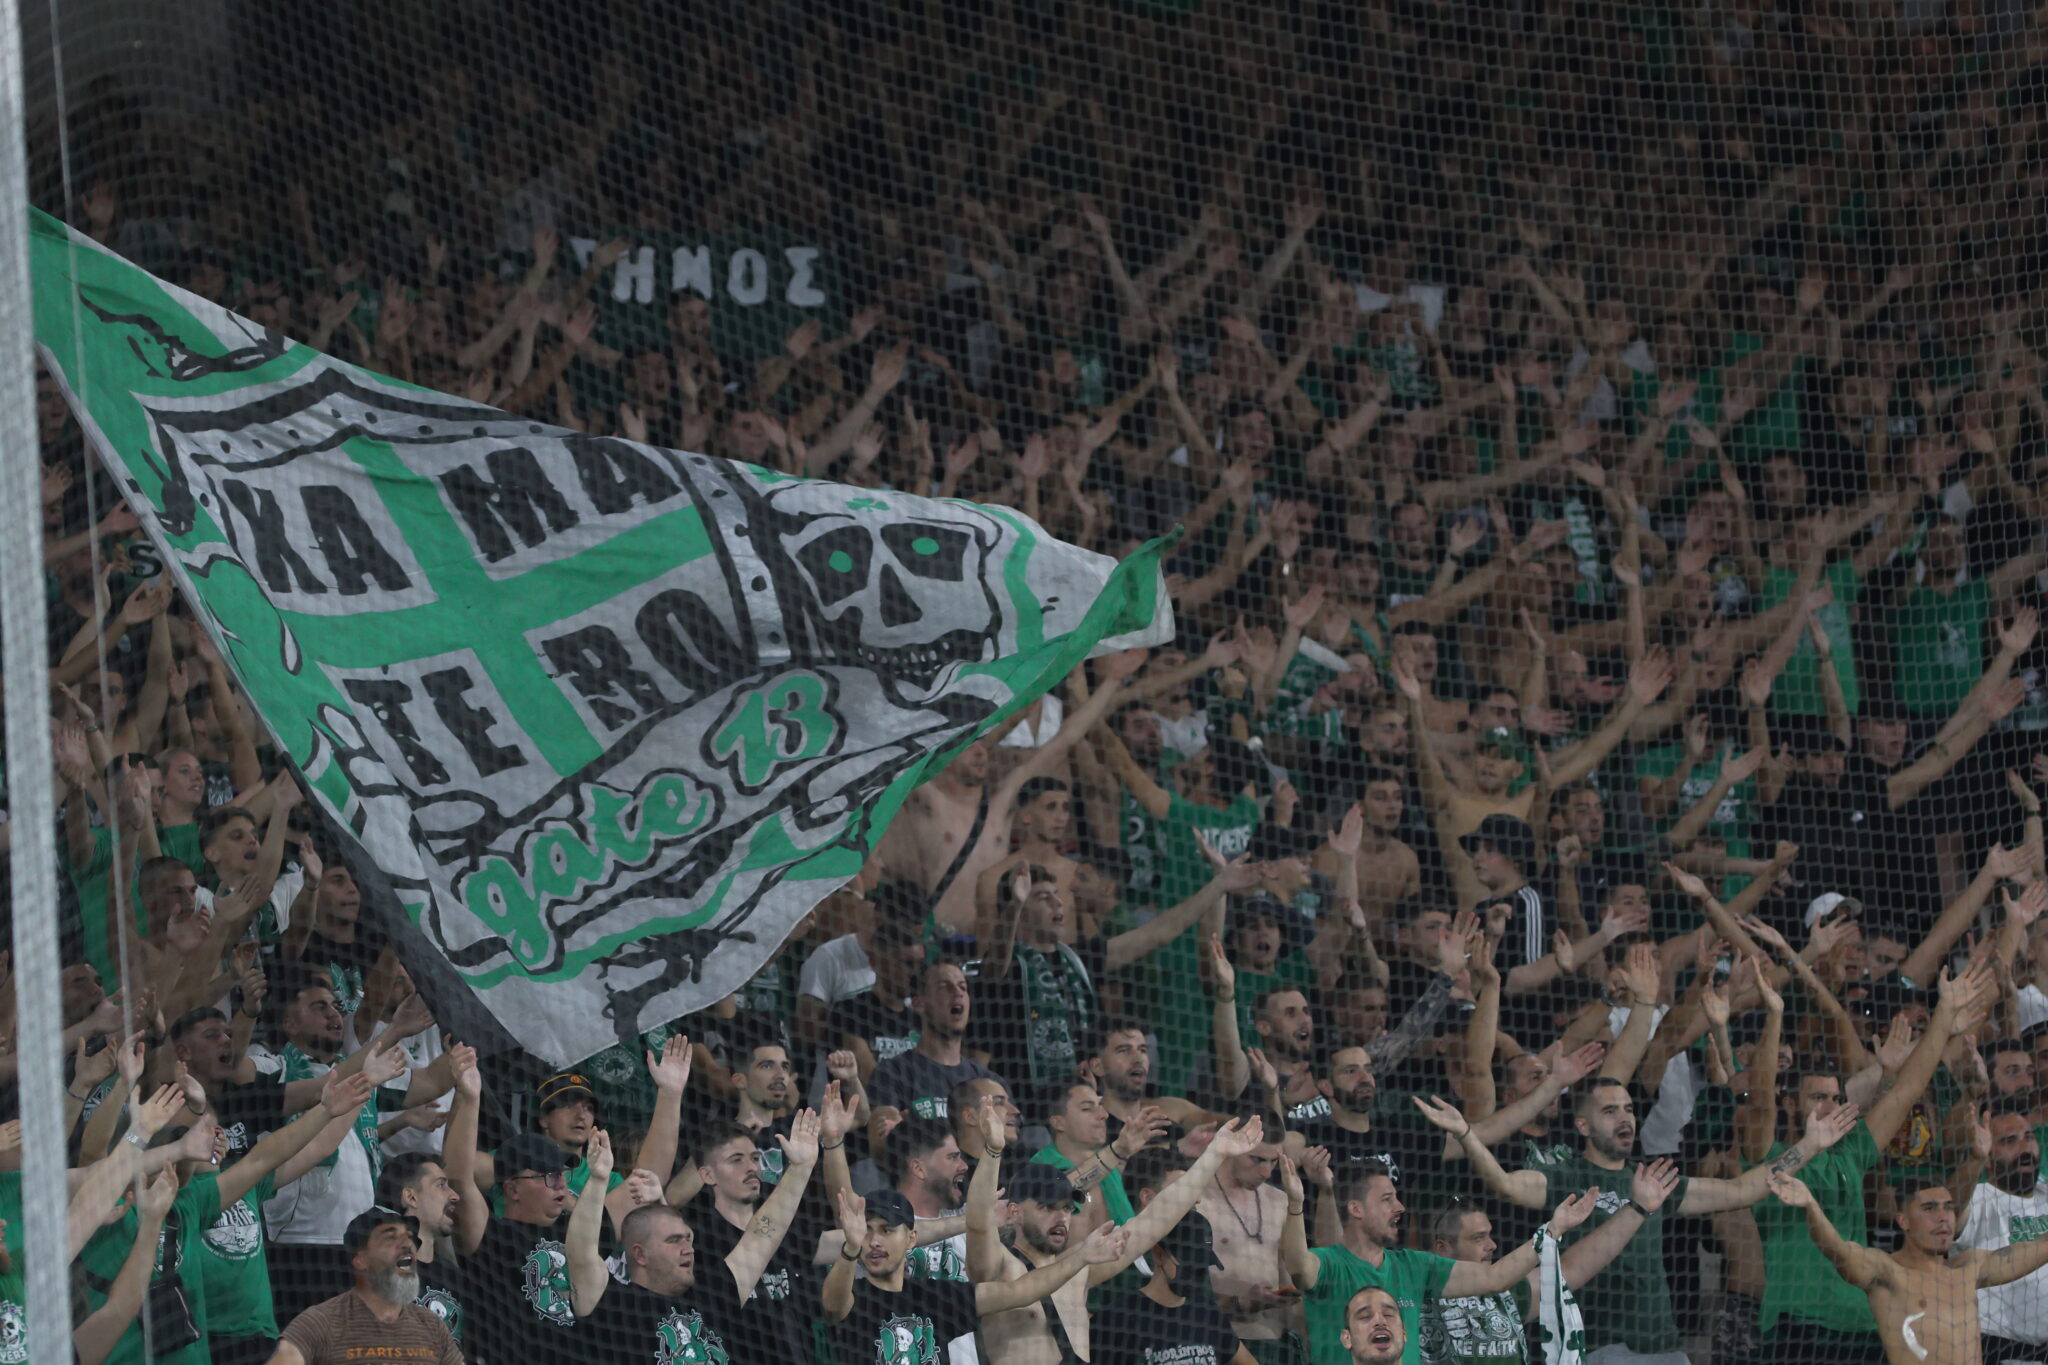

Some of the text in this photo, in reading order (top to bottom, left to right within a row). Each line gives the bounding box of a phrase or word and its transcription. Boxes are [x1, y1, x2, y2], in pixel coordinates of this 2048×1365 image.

[465, 673, 835, 966] gate 13
[346, 1346, 403, 1361] STARTS
